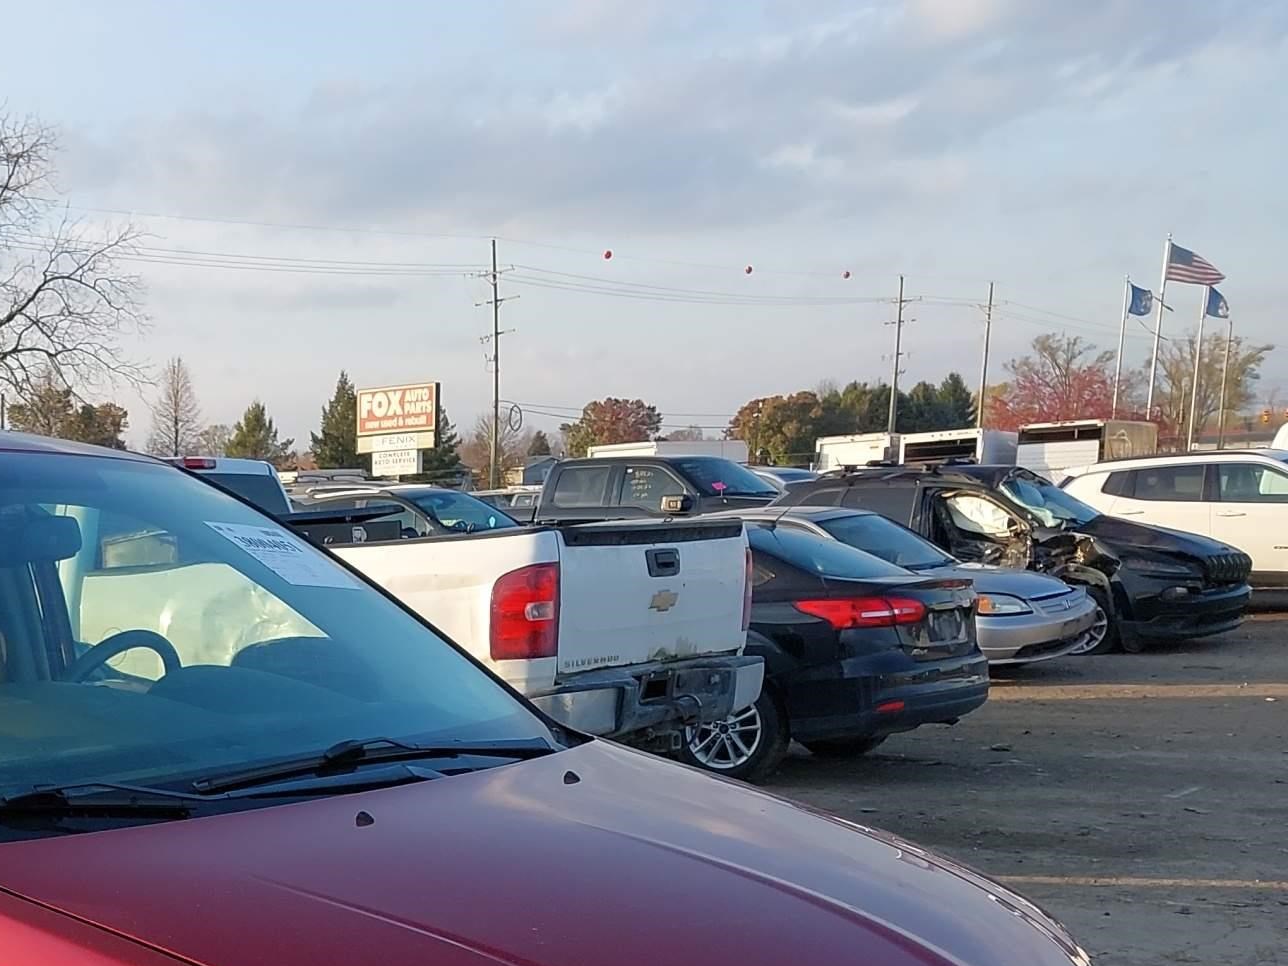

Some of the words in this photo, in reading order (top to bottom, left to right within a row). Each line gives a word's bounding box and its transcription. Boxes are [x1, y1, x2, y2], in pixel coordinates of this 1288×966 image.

[404, 387, 429, 402] AUTO
[361, 390, 403, 418] FOX
[404, 400, 432, 415] PARTS
[382, 435, 416, 445] FENIX
[564, 655, 620, 668] SILVERADO
